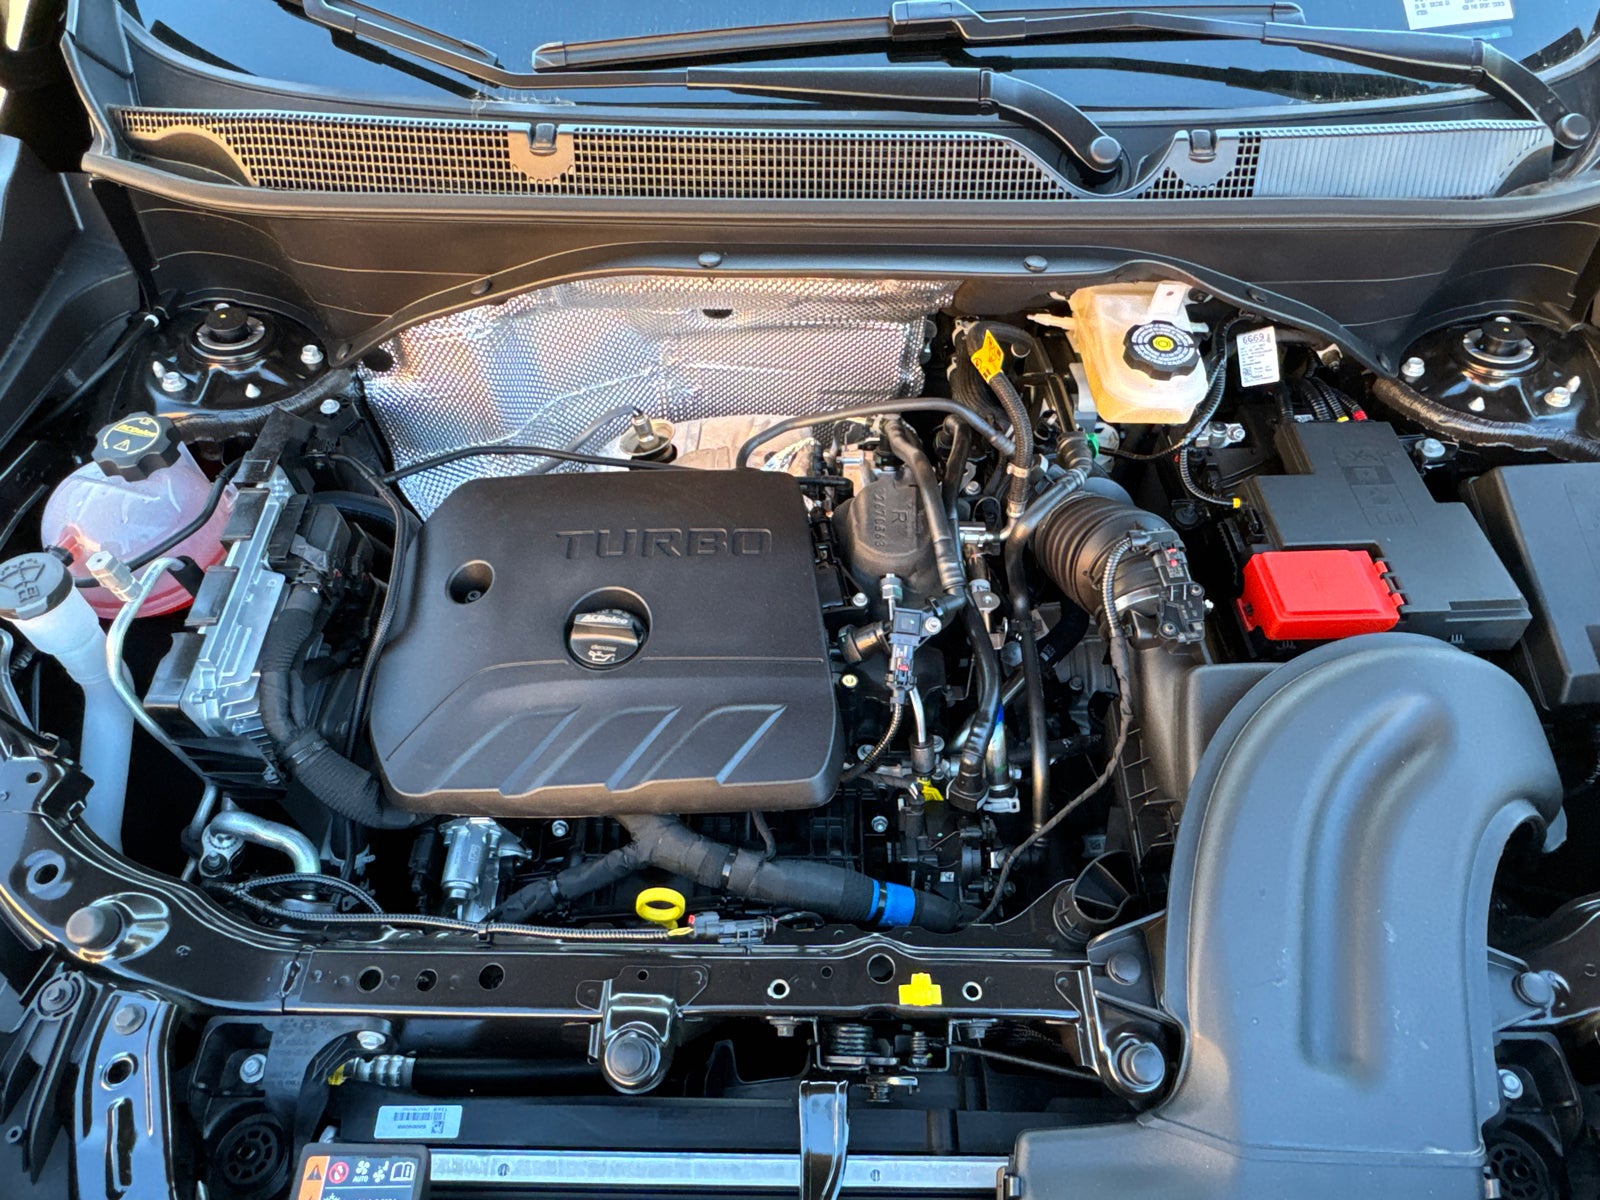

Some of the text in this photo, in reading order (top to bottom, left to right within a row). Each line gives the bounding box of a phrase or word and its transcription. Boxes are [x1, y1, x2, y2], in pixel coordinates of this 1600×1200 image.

[556, 528, 772, 560] TURBO
[580, 614, 628, 625] ACDelco
[352, 1175, 369, 1183] AUTO
